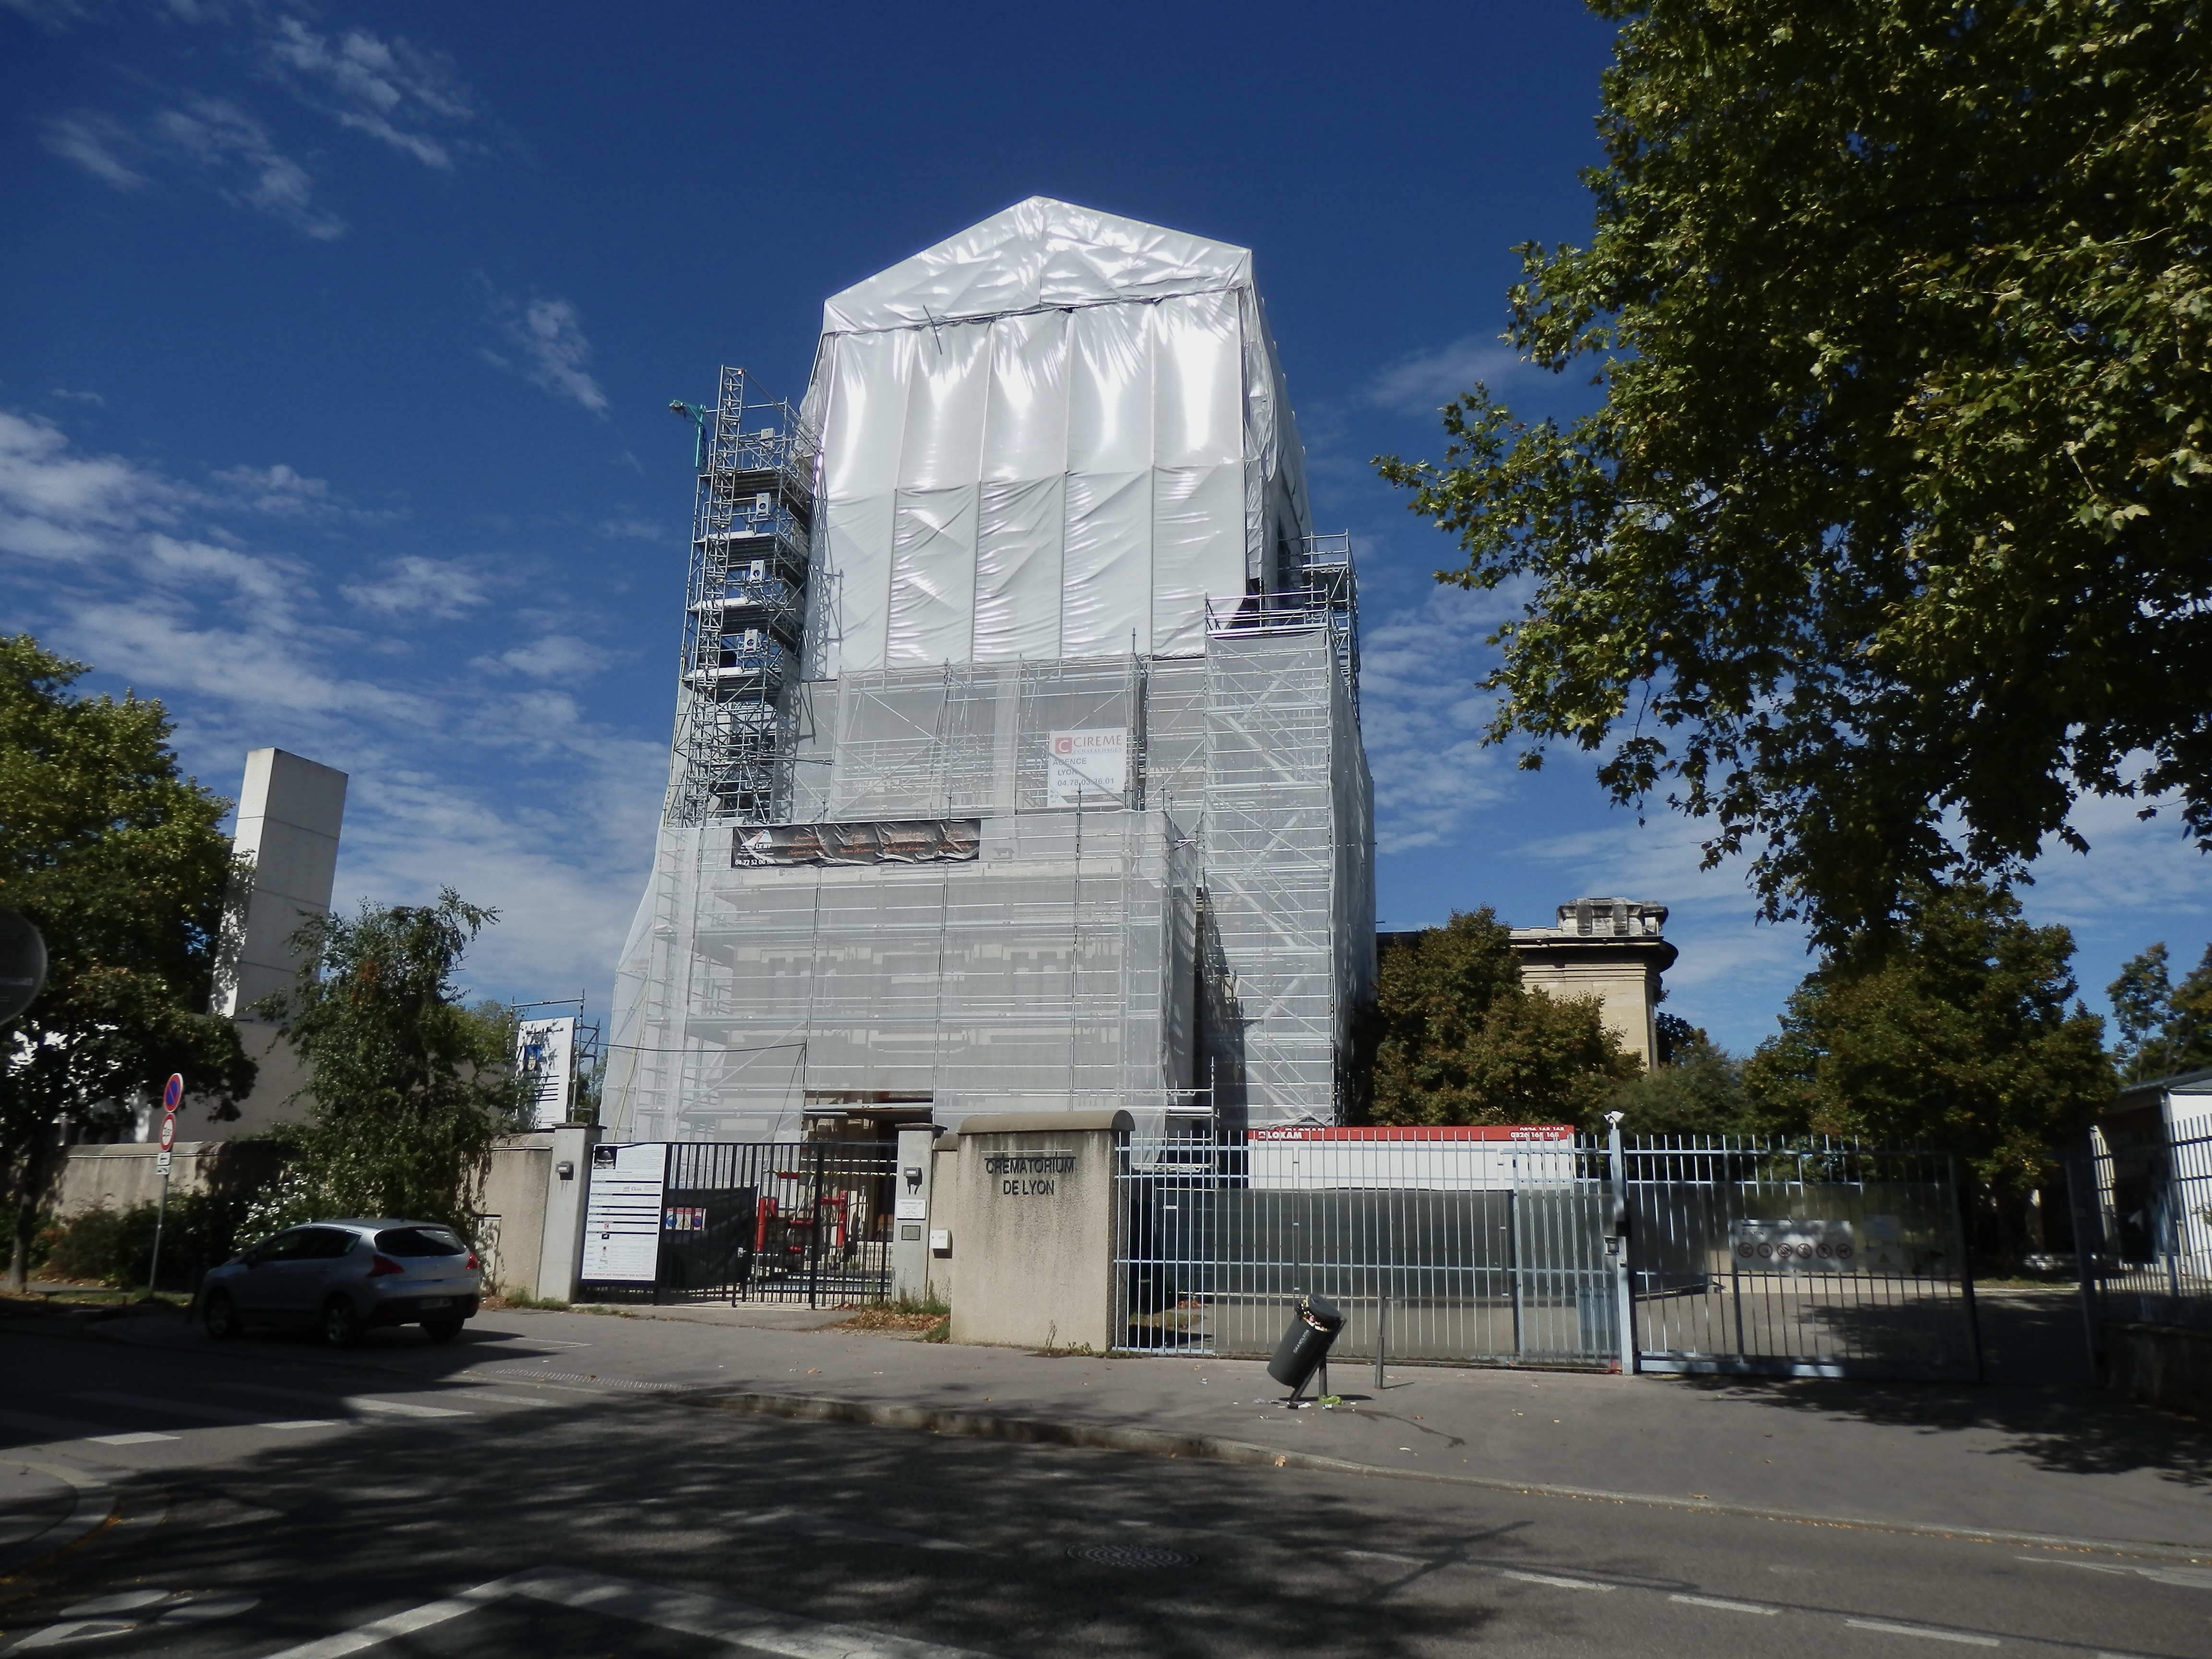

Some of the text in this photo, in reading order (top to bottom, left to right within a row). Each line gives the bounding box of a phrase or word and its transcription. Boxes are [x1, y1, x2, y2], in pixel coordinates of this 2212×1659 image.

[1073, 735, 1122, 747] CIREME
[1058, 778, 1114, 786] 04.7803.36.01
[986, 1157, 1074, 1174] CREMATORIUM
[1003, 1179, 1055, 1195] DE LYON
